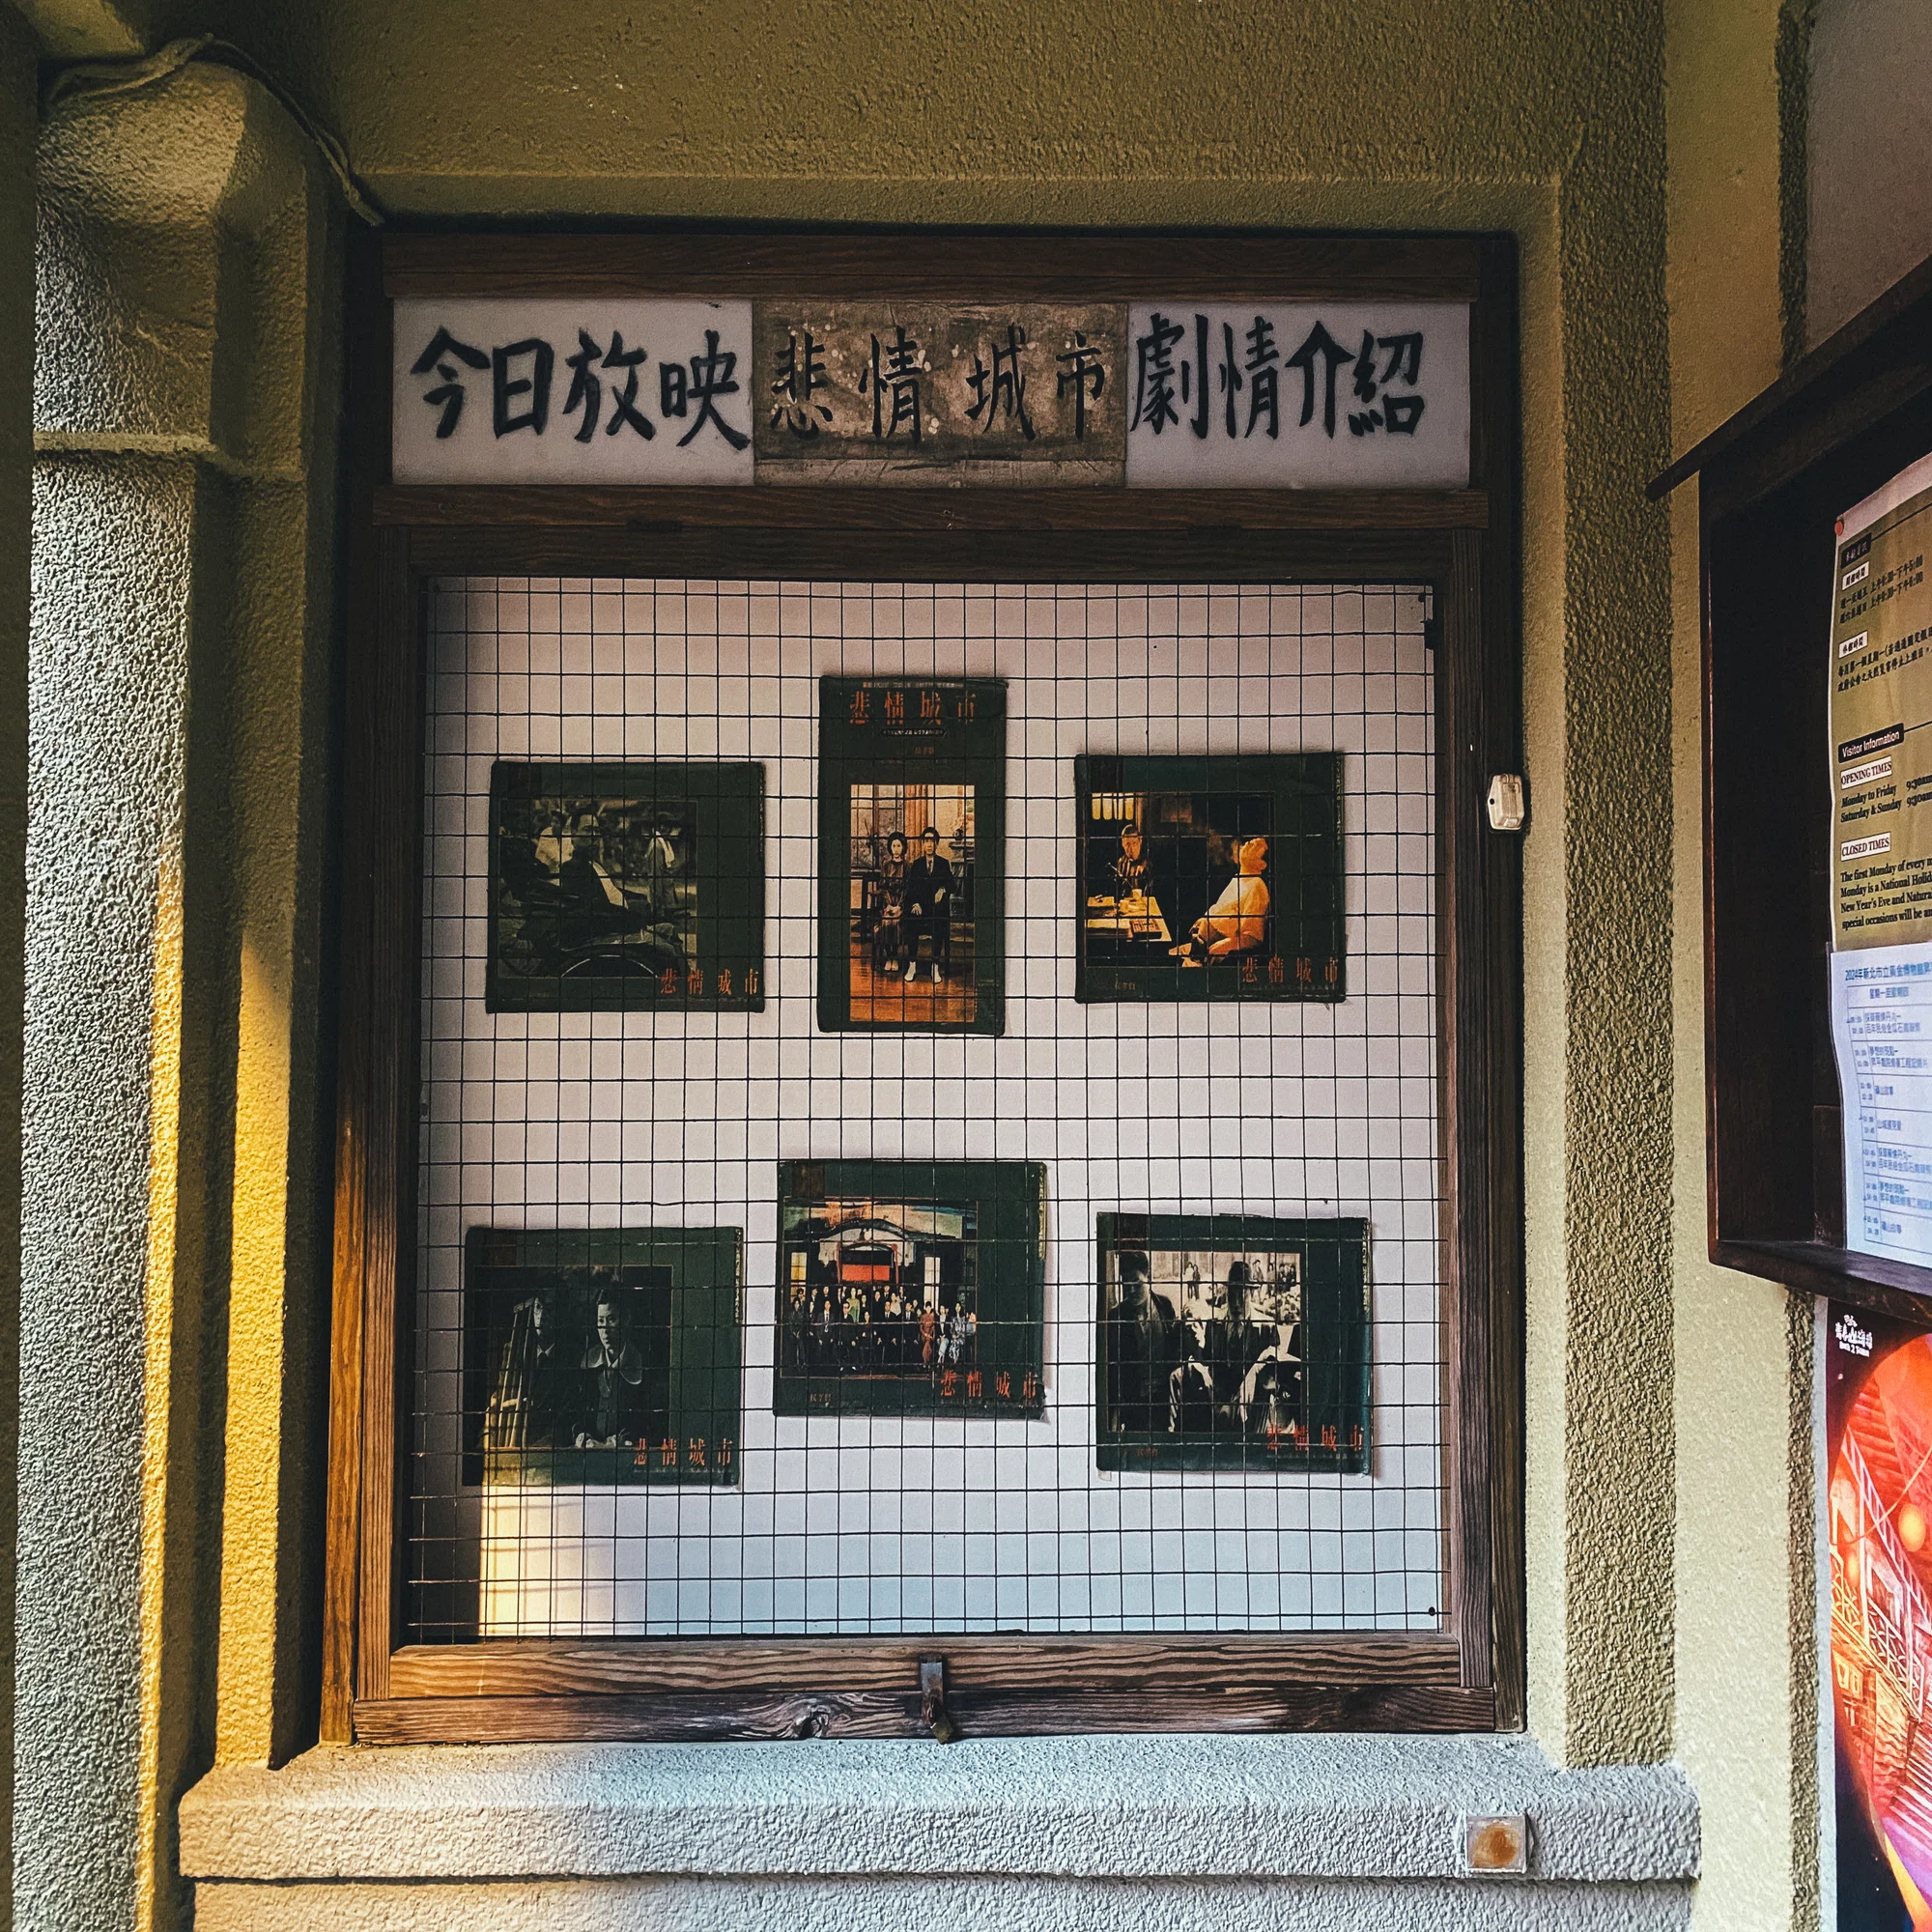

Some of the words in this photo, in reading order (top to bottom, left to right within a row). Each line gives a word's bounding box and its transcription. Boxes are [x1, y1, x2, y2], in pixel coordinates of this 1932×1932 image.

[410, 326, 752, 451] 今日放映
[770, 323, 1105, 443] 悲情城市
[1128, 310, 1426, 440] 劇情介紹
[1842, 743, 1863, 758] Visitor
[1863, 730, 1900, 751] Information
[1841, 767, 1871, 784] OPENING
[1871, 761, 1892, 776] TIMES
[1841, 792, 1867, 808] Monday
[1868, 790, 1875, 801] to
[1876, 783, 1897, 798] Friday
[1840, 808, 1870, 823] Saturday
[1877, 799, 1902, 813] Sunday
[1841, 842, 1867, 857] CLOSED
[1868, 837, 1889, 851] TIMES
[1840, 871, 1853, 883] The
[1854, 868, 1868, 880] first
[1869, 863, 1897, 877] Monday
[1897, 860, 1906, 871] of
[1906, 859, 1925, 870] every
[1840, 885, 1866, 898] Monday
[1867, 882, 1873, 894] is
[1875, 883, 1879, 893] a
[1880, 875, 1911, 891] National
[1840, 900, 1855, 913] New
[1856, 897, 1877, 911] Year's
[1878, 896, 1890, 907] Eve
[1891, 893, 1906, 905] and
[1842, 915, 1864, 931] special
[1865, 912, 1897, 925] occasions
[1899, 908, 1913, 921] will
[1914, 907, 1922, 919] be
